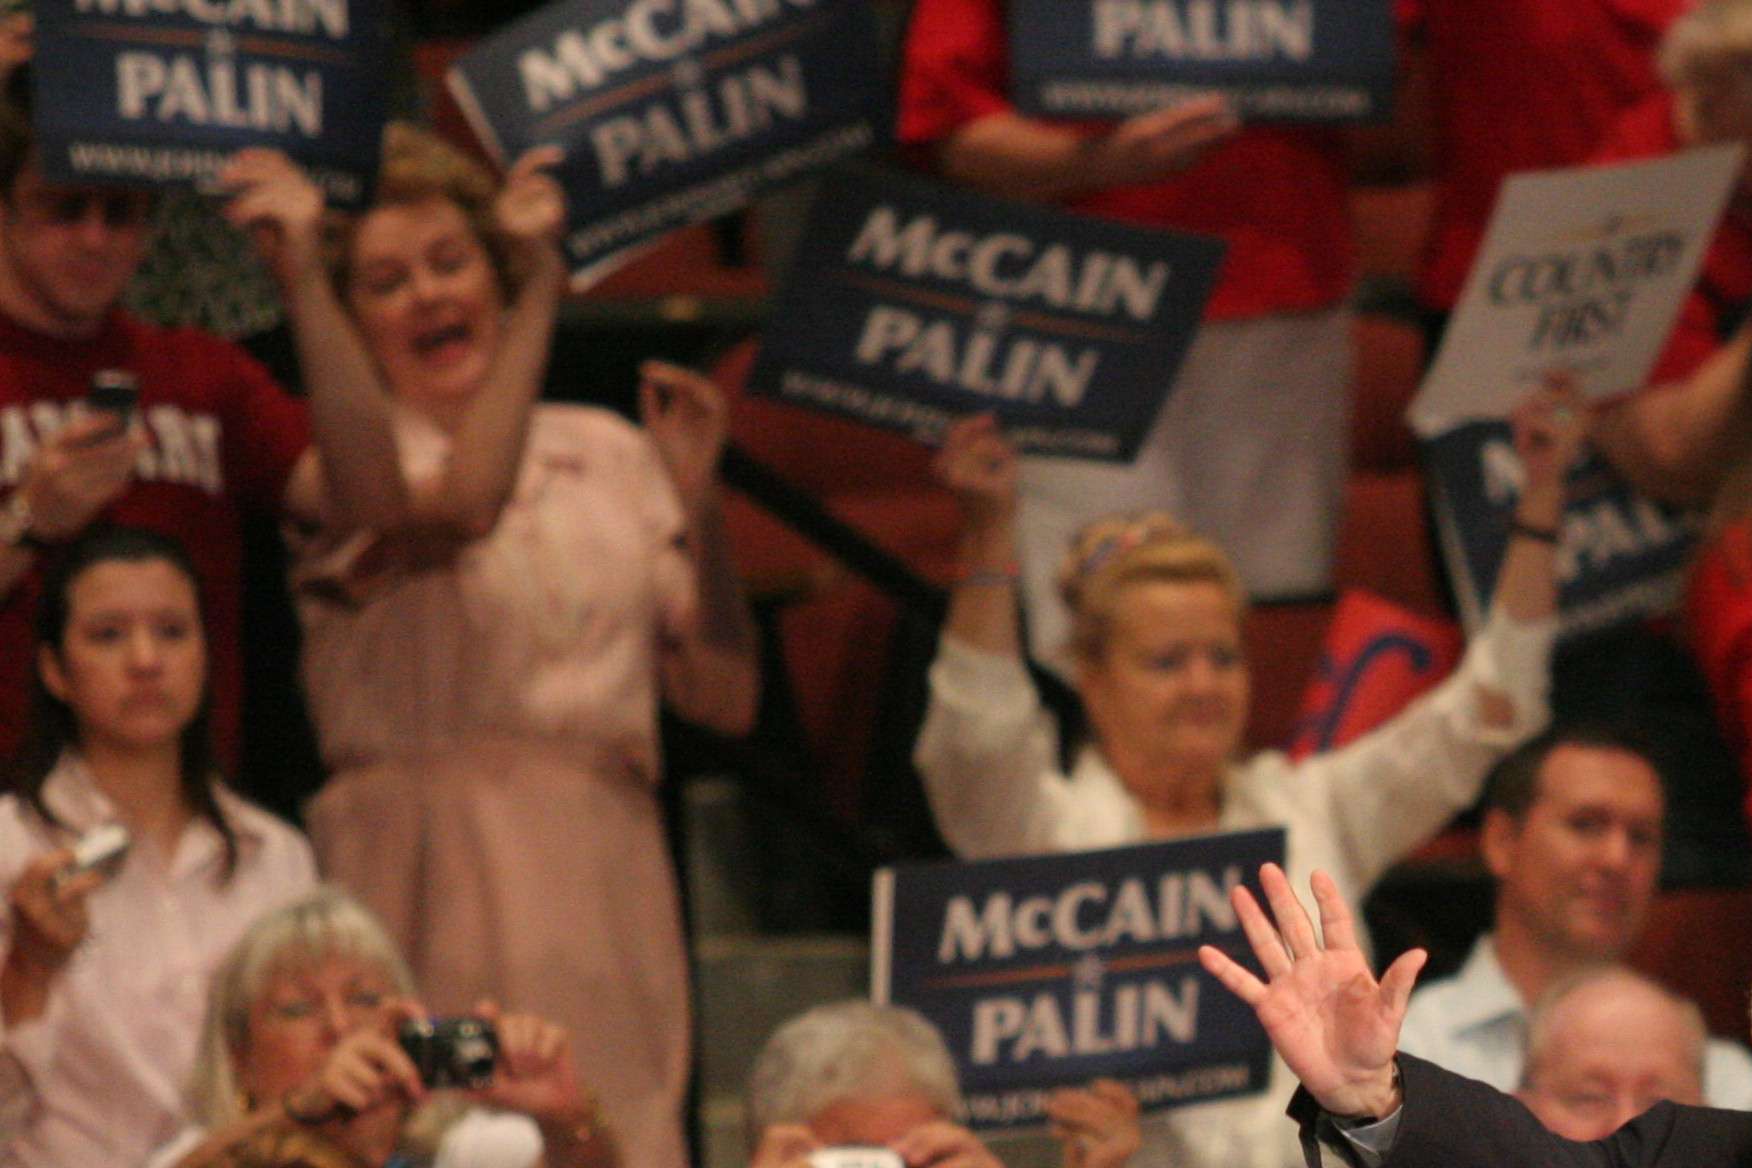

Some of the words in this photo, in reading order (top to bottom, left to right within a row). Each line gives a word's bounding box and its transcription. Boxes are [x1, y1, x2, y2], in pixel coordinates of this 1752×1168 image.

[1094, 0, 1313, 62] PALIN
[115, 51, 324, 139] PALIN
[590, 56, 805, 189] PALIN
[848, 205, 1170, 321] McCAIN
[855, 304, 1101, 408] PALIN
[937, 865, 1244, 964] McCAIN
[971, 976, 1200, 1066] PALIN
